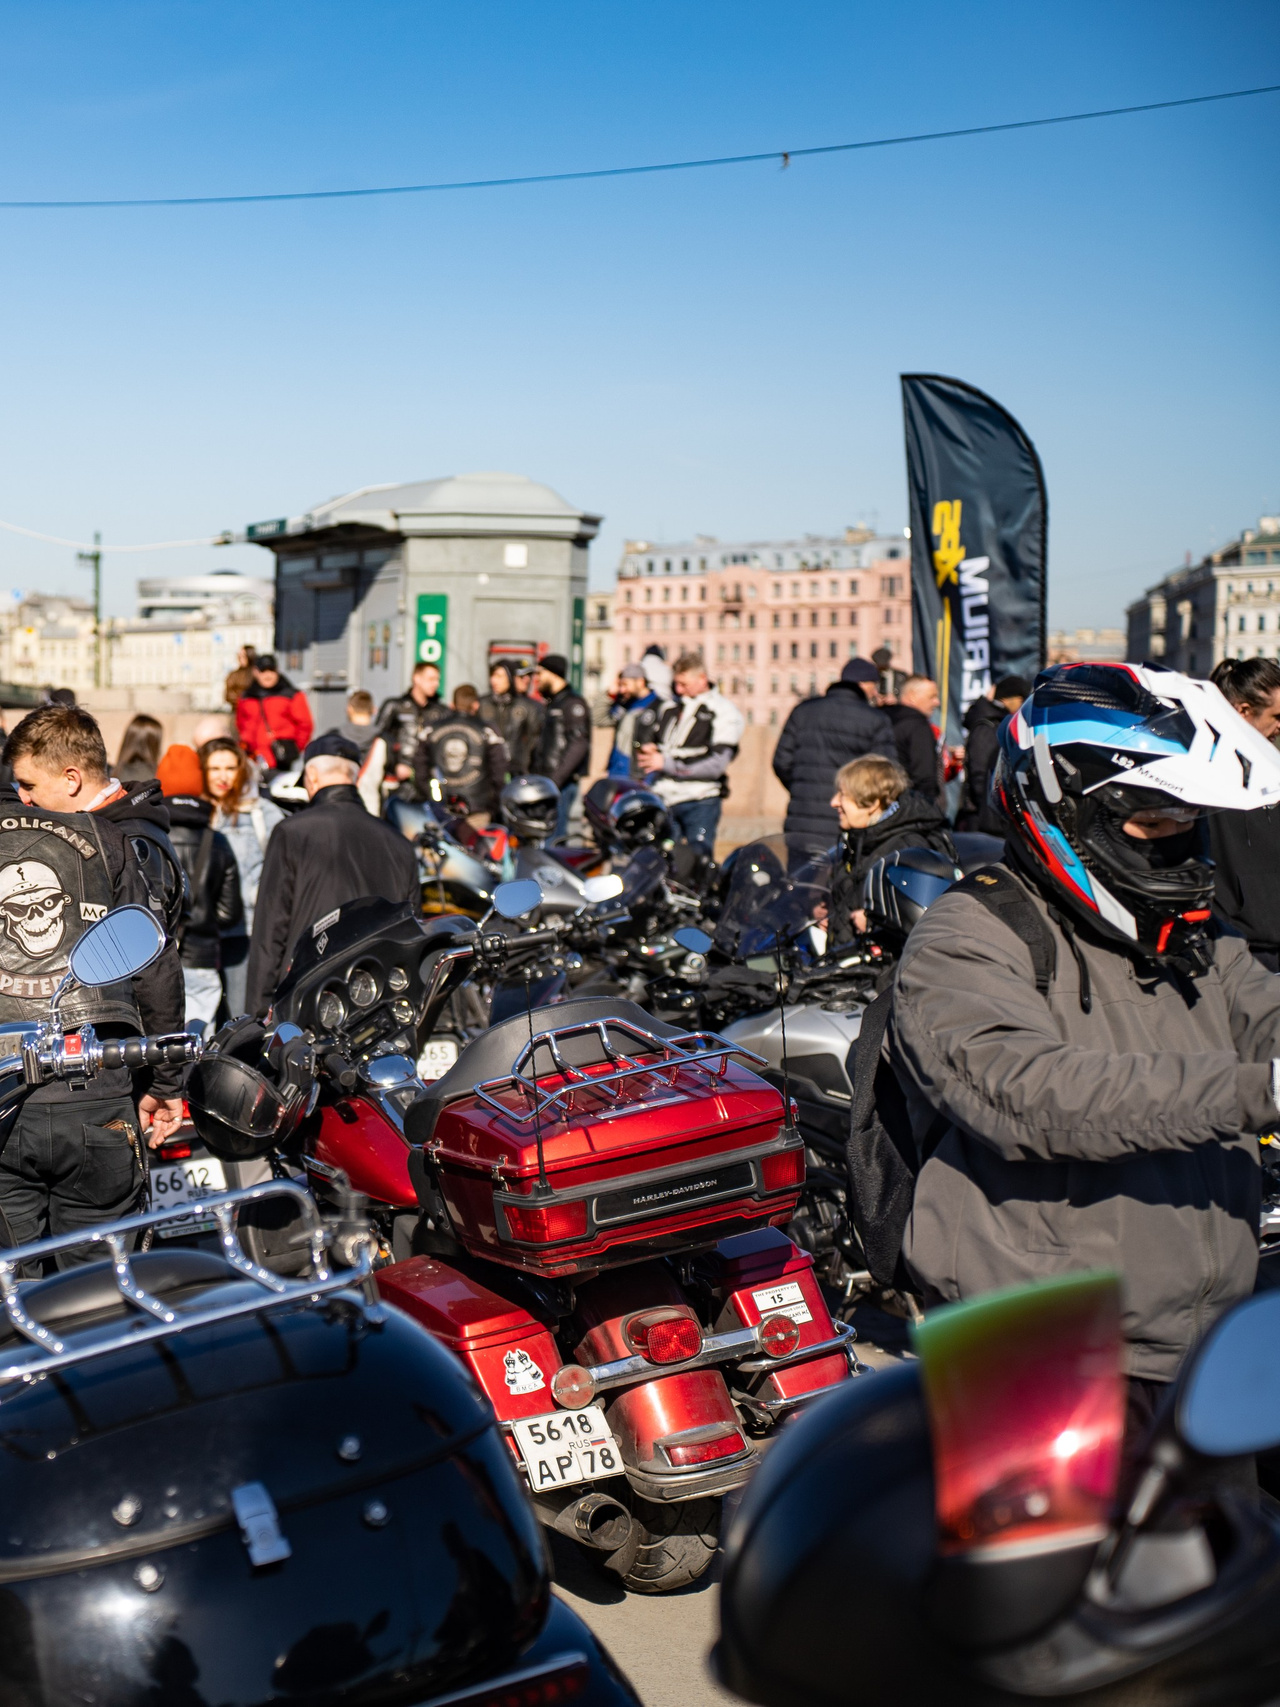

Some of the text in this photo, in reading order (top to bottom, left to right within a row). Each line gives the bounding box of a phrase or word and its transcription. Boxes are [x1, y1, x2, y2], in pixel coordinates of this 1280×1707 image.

[1111, 752, 1135, 770] LS2
[83, 905, 108, 920] MC
[155, 1167, 212, 1195] 6612
[187, 1188, 209, 1198] RUS
[632, 1179, 718, 1205] HARLEY-DAVIDSON
[765, 1287, 789, 1295] PROPERTY
[771, 1294, 783, 1304] 15
[516, 1382, 539, 1393] BMCA
[527, 1413, 593, 1446] 5618
[568, 1439, 591, 1450] RUS
[538, 1447, 616, 1485] AP 78
